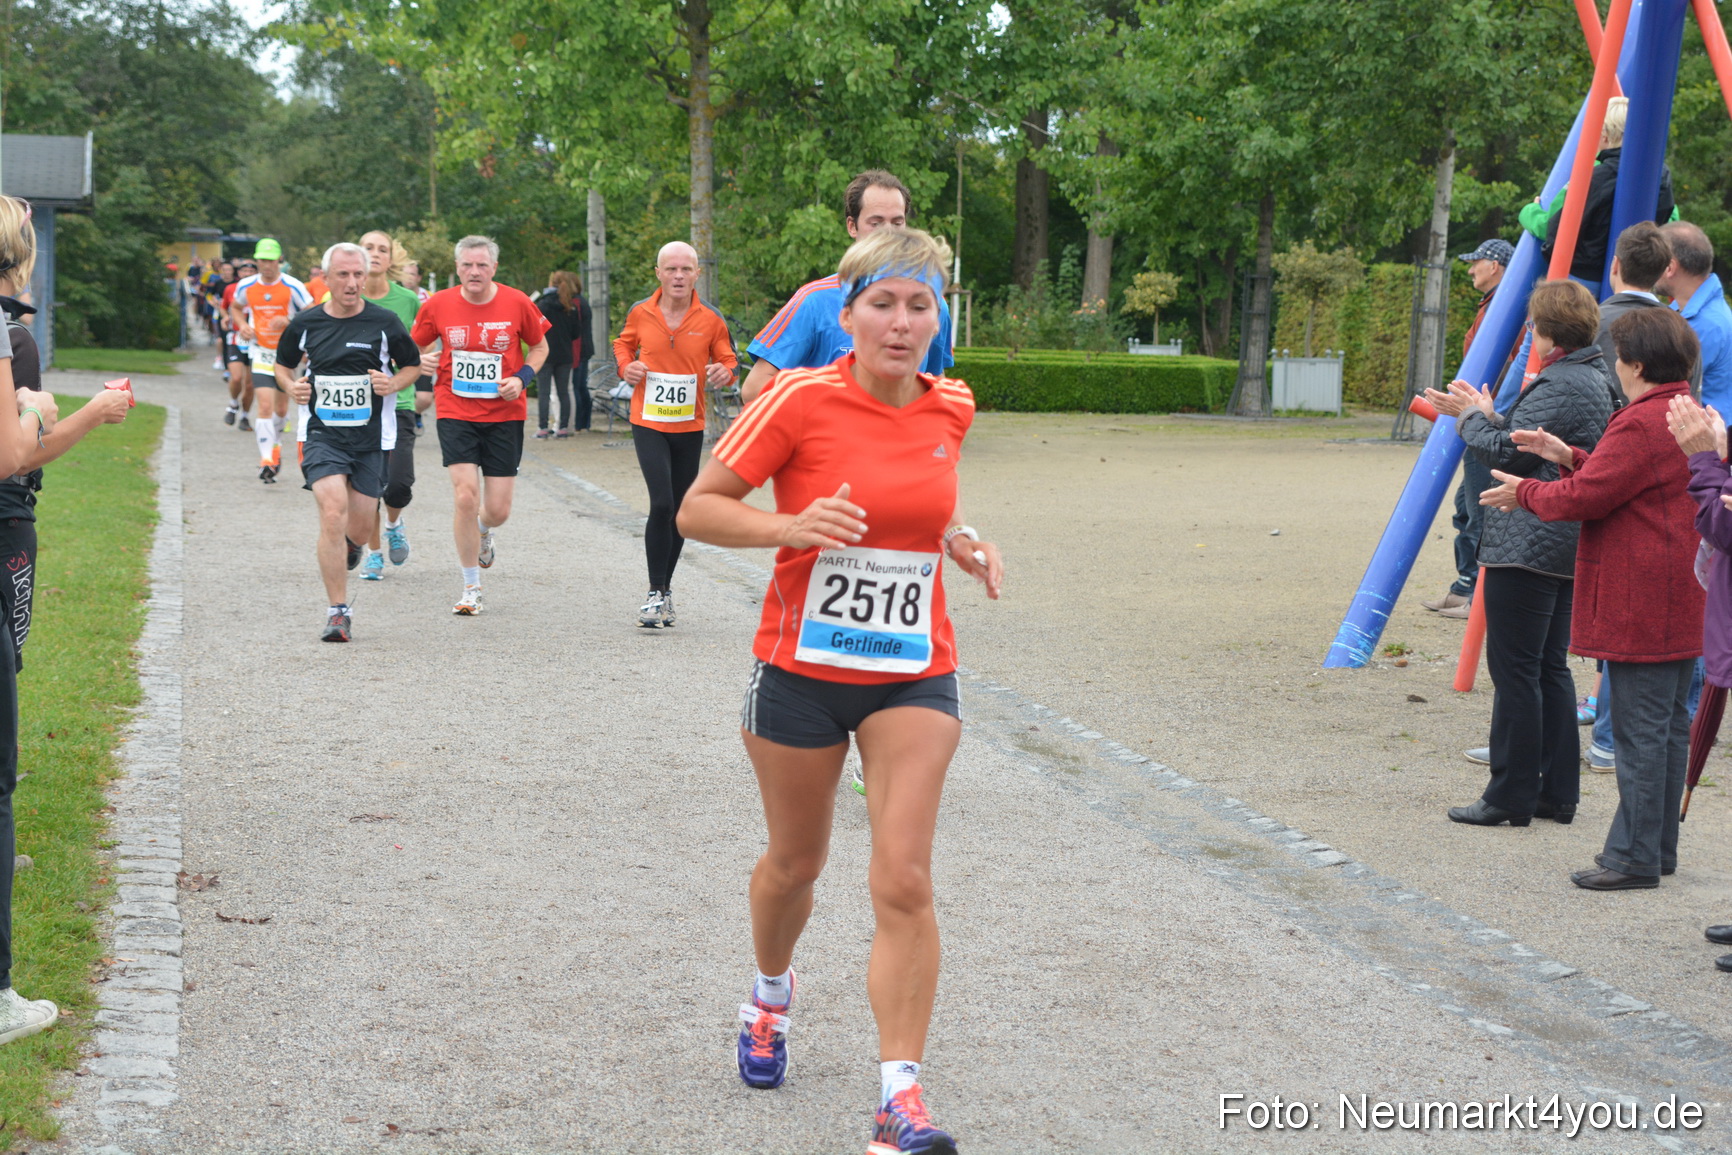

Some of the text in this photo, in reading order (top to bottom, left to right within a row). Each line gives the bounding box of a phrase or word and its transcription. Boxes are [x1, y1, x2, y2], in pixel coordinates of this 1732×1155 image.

[456, 362, 496, 380] 2043
[647, 375, 662, 383] PARTL
[322, 388, 365, 407] 2458
[655, 385, 687, 404] 246
[331, 411, 355, 419] Alfons
[657, 407, 682, 416] Roland
[817, 556, 917, 575] PARTL Neumarkt
[819, 573, 921, 627] 2518
[831, 631, 903, 655] Gerlinde
